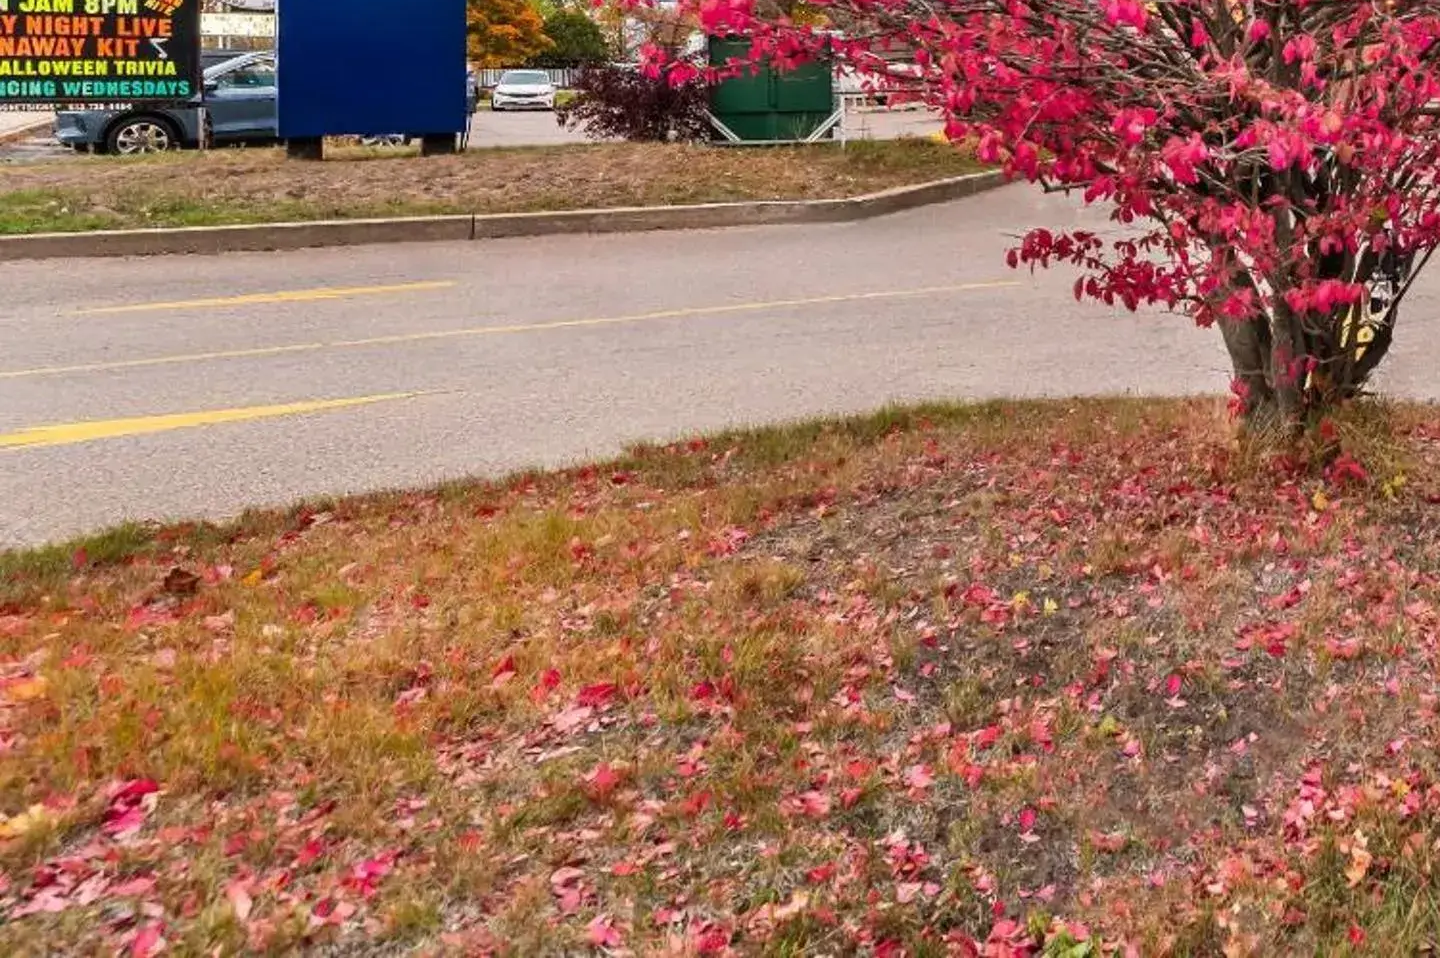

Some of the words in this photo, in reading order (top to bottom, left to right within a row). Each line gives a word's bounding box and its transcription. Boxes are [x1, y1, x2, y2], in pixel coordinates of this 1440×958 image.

[26, 14, 104, 36] NIGHT
[117, 16, 173, 37] LIVE
[0, 36, 85, 57] NAWAY
[97, 37, 139, 57] KIT
[0, 59, 108, 76] ALLOWEEN
[113, 60, 177, 76] TRIVIA
[63, 80, 190, 97] WEDNESDAYS
